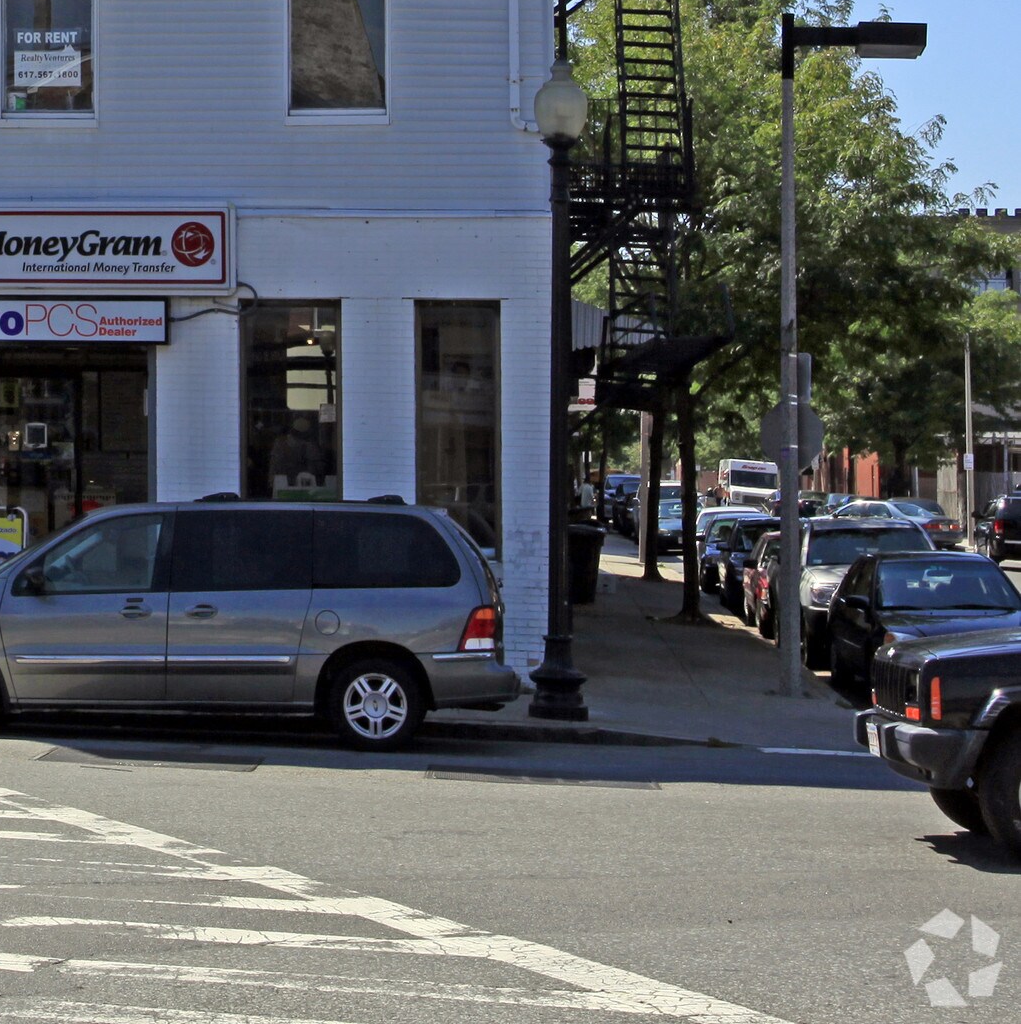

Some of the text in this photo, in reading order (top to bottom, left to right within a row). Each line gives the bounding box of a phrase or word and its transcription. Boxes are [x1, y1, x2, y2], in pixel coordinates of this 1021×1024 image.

[17, 31, 78, 44] FOR RENT
[22, 262, 176, 275] International Money Transfer
[99, 316, 163, 327] Authorized
[99, 327, 137, 337] Dealer
